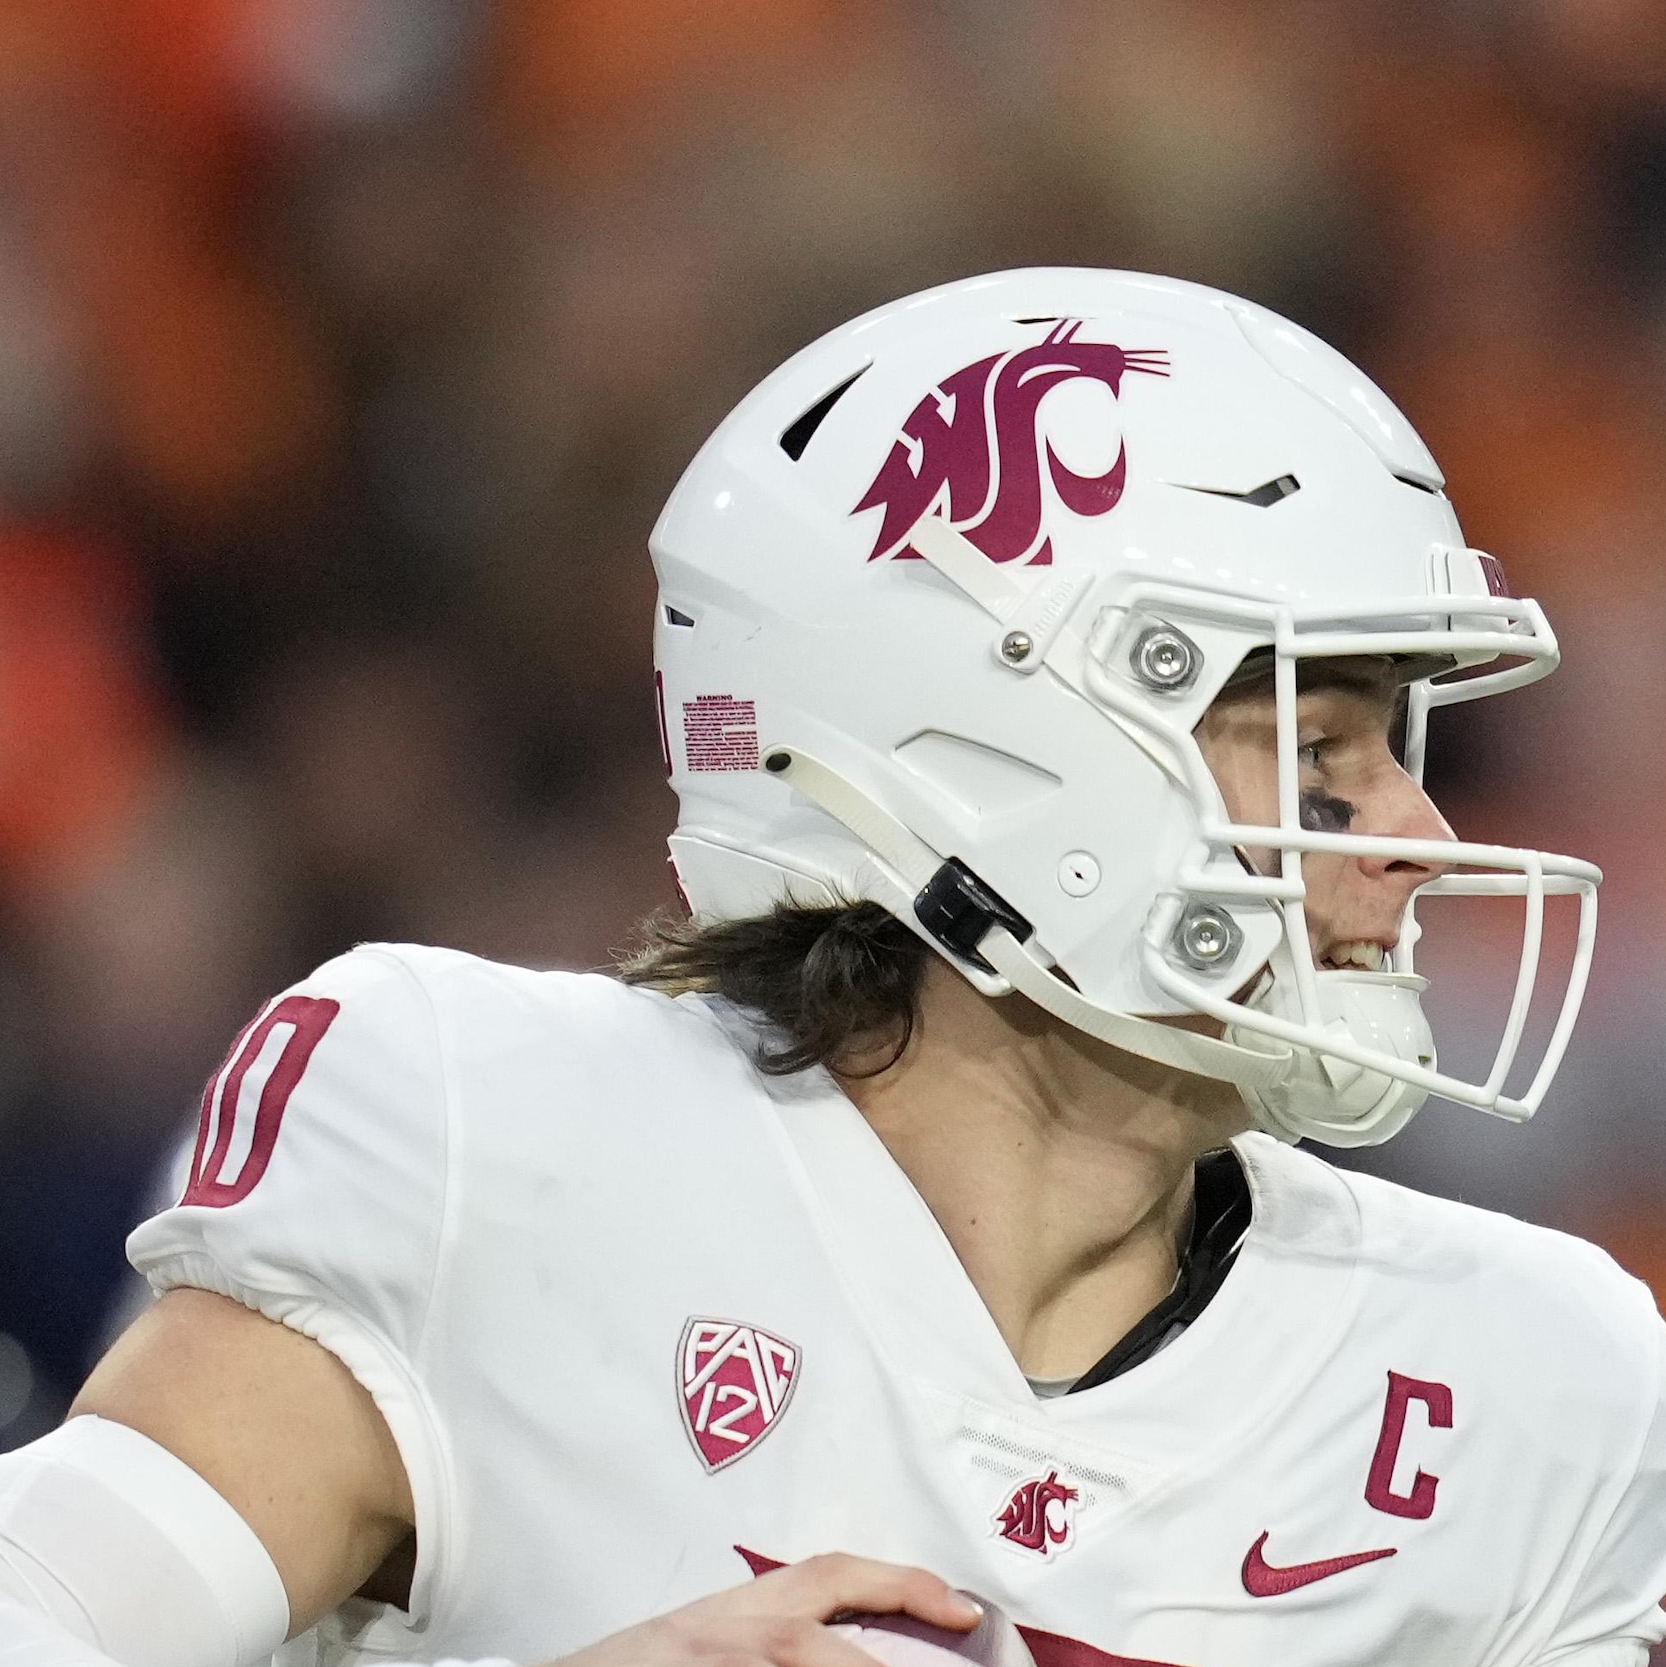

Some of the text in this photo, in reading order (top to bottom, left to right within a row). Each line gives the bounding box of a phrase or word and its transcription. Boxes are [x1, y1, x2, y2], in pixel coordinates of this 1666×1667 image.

[684, 1321, 797, 1425] PAC
[695, 1381, 758, 1444] 12
[1364, 1369, 1453, 1520] C
